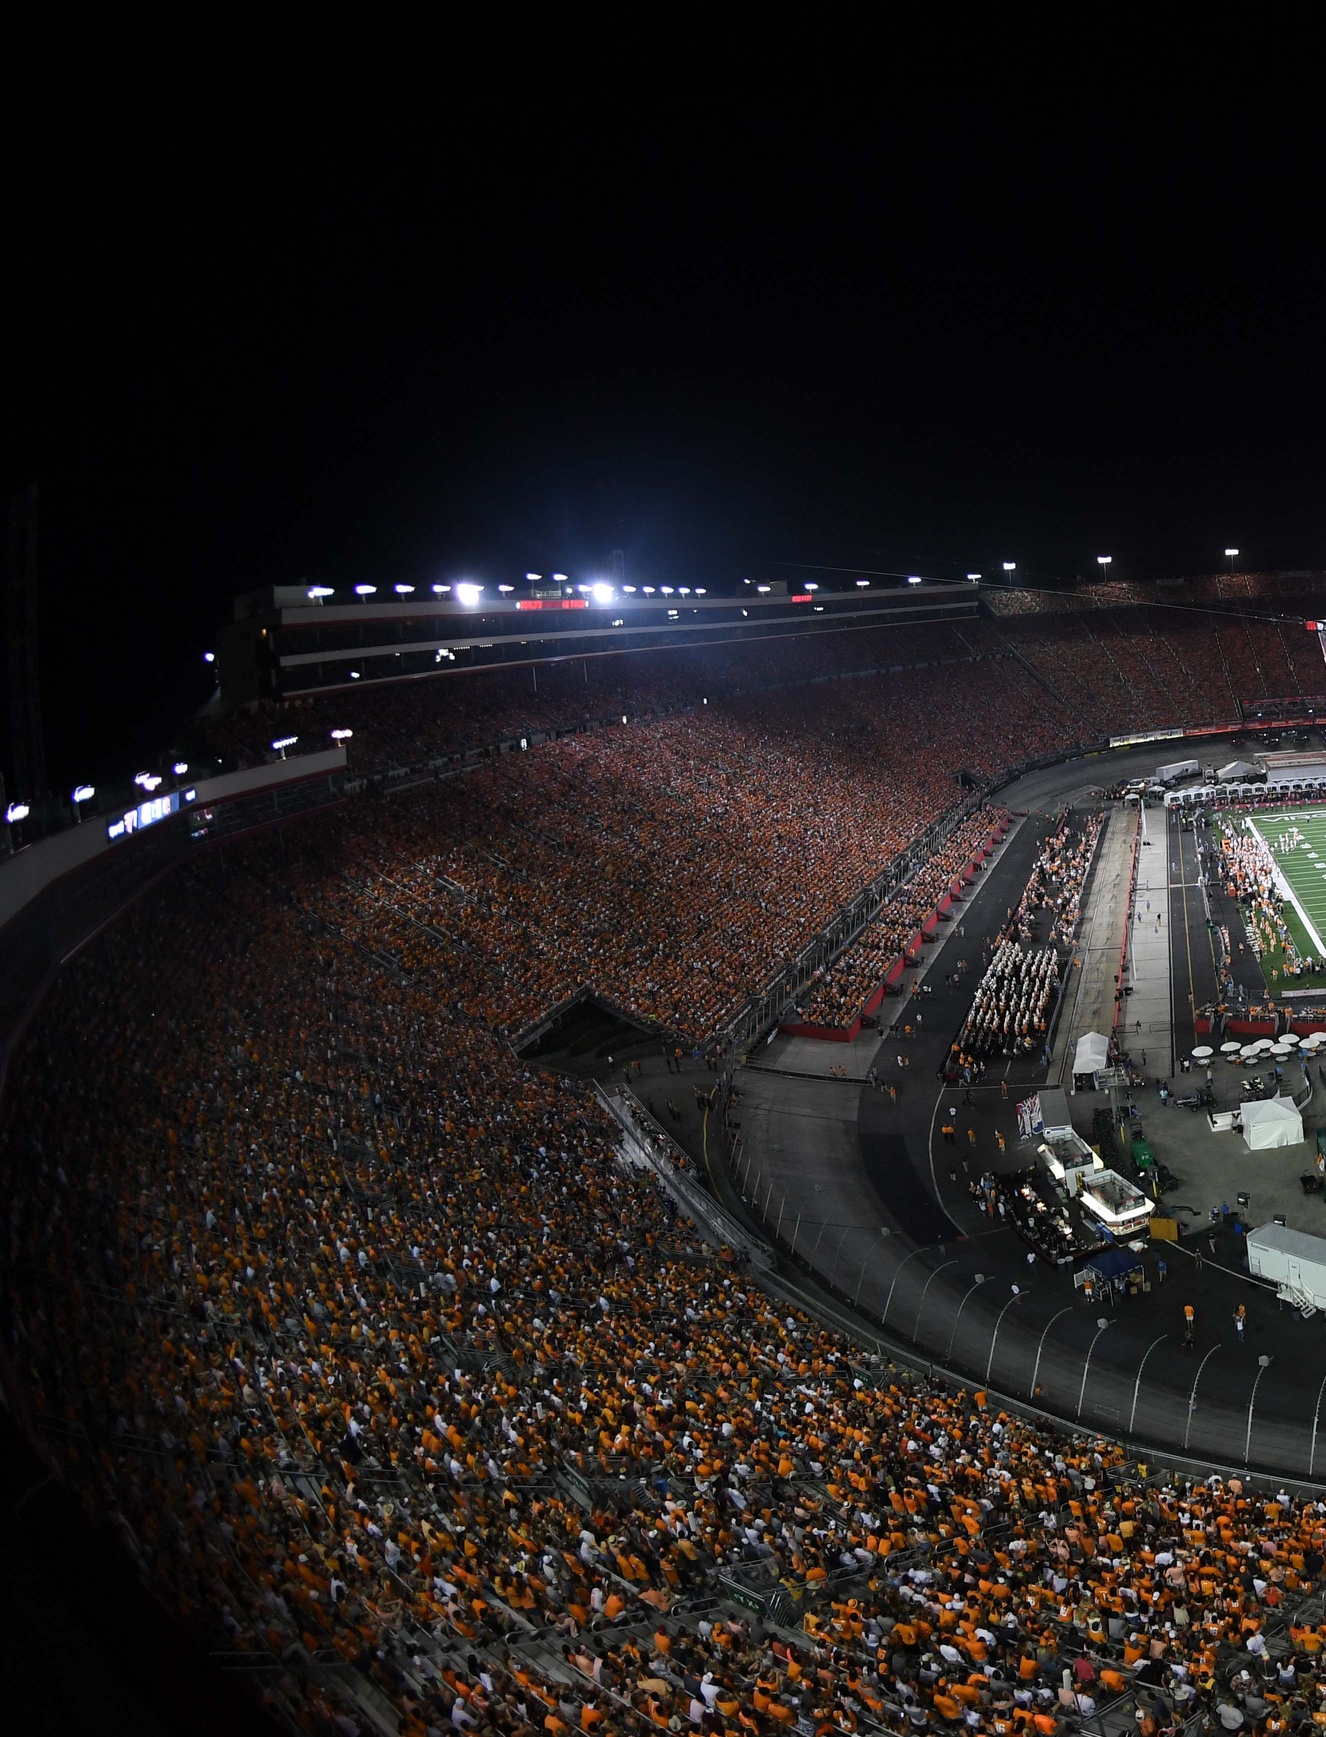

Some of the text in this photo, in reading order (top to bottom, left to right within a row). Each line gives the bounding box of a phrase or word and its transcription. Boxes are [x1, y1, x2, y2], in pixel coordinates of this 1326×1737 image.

[877, 1649, 886, 1659] 16
[995, 1723, 1005, 1733] 16
[1271, 1721, 1280, 1731] 16
